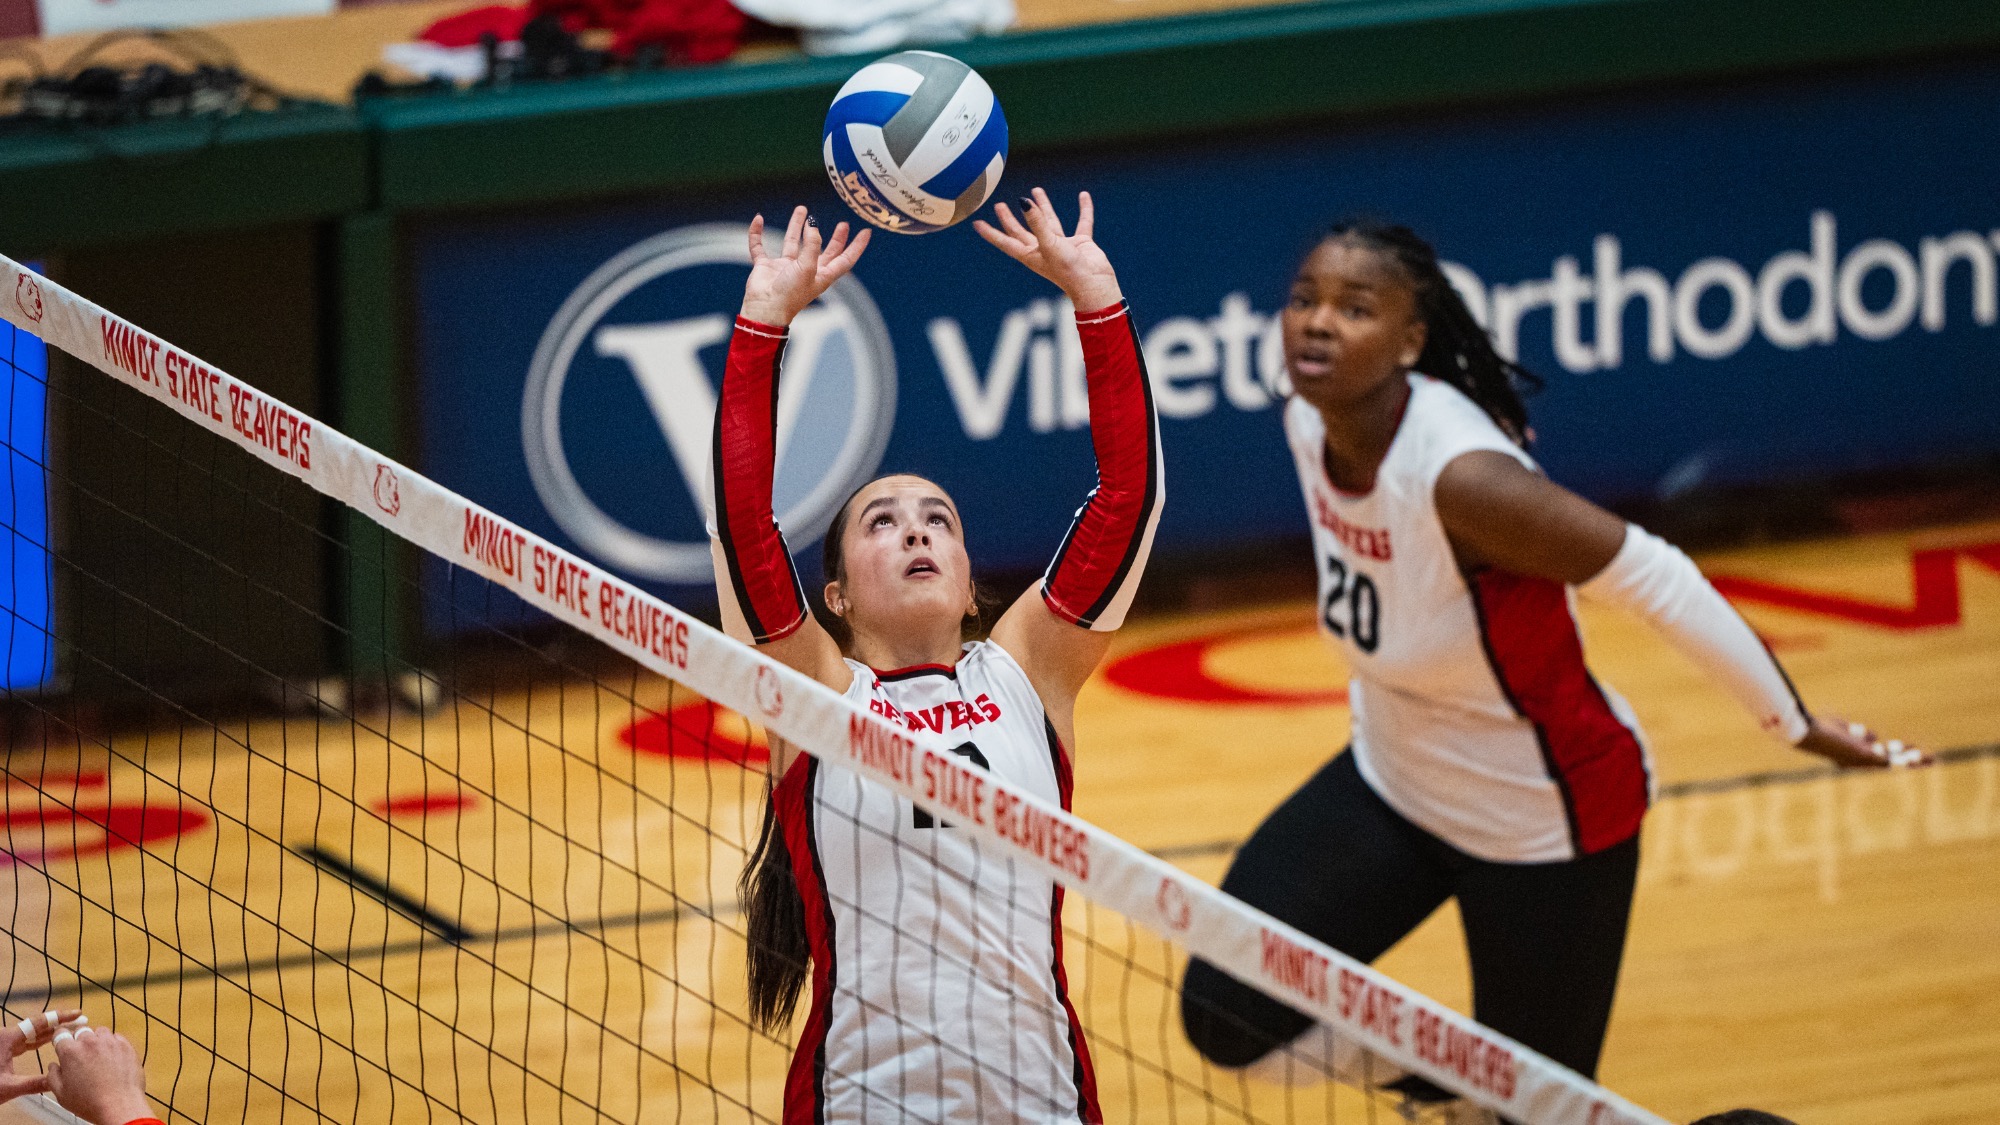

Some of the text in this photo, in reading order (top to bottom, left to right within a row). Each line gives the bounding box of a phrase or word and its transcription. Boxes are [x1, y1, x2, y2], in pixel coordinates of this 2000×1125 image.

[843, 171, 912, 229] NCAA
[861, 148, 898, 189] Touch
[1437, 209, 2000, 375] rthodon
[101, 314, 311, 470] MINOT STATE BEAVERS
[464, 507, 689, 671] MINOT STATE BEAVERS
[1325, 555, 1380, 655] 20
[849, 711, 916, 787] MINOT
[922, 750, 986, 826] STATE
[993, 788, 1090, 882] BEAVERS
[1260, 927, 1517, 1101] MINOT STATE BEAVERS
